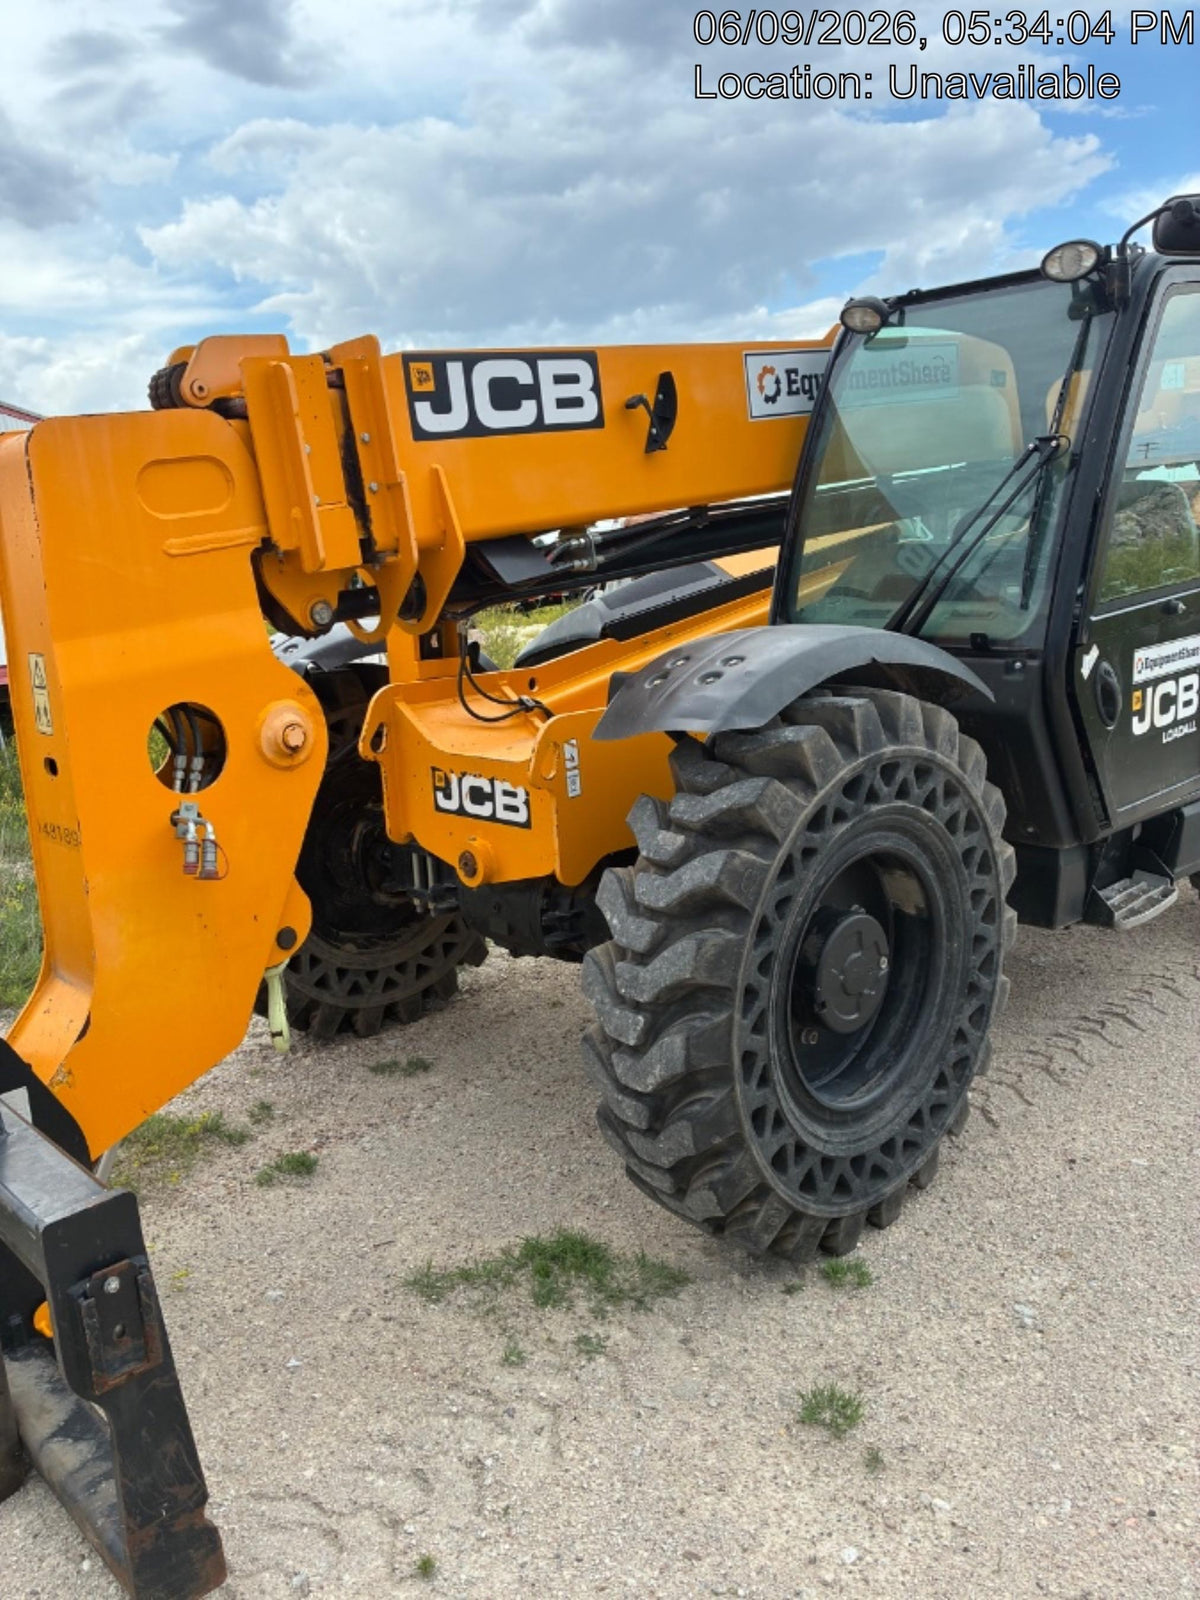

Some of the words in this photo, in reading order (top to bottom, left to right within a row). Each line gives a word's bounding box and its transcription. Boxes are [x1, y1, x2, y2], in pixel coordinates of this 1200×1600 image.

[413, 358, 599, 433] JCB
[785, 359, 953, 401] EqumentShare
[1144, 646, 1200, 671] EquipmentShar
[1131, 673, 1200, 736] JCB
[436, 774, 529, 824] JCB
